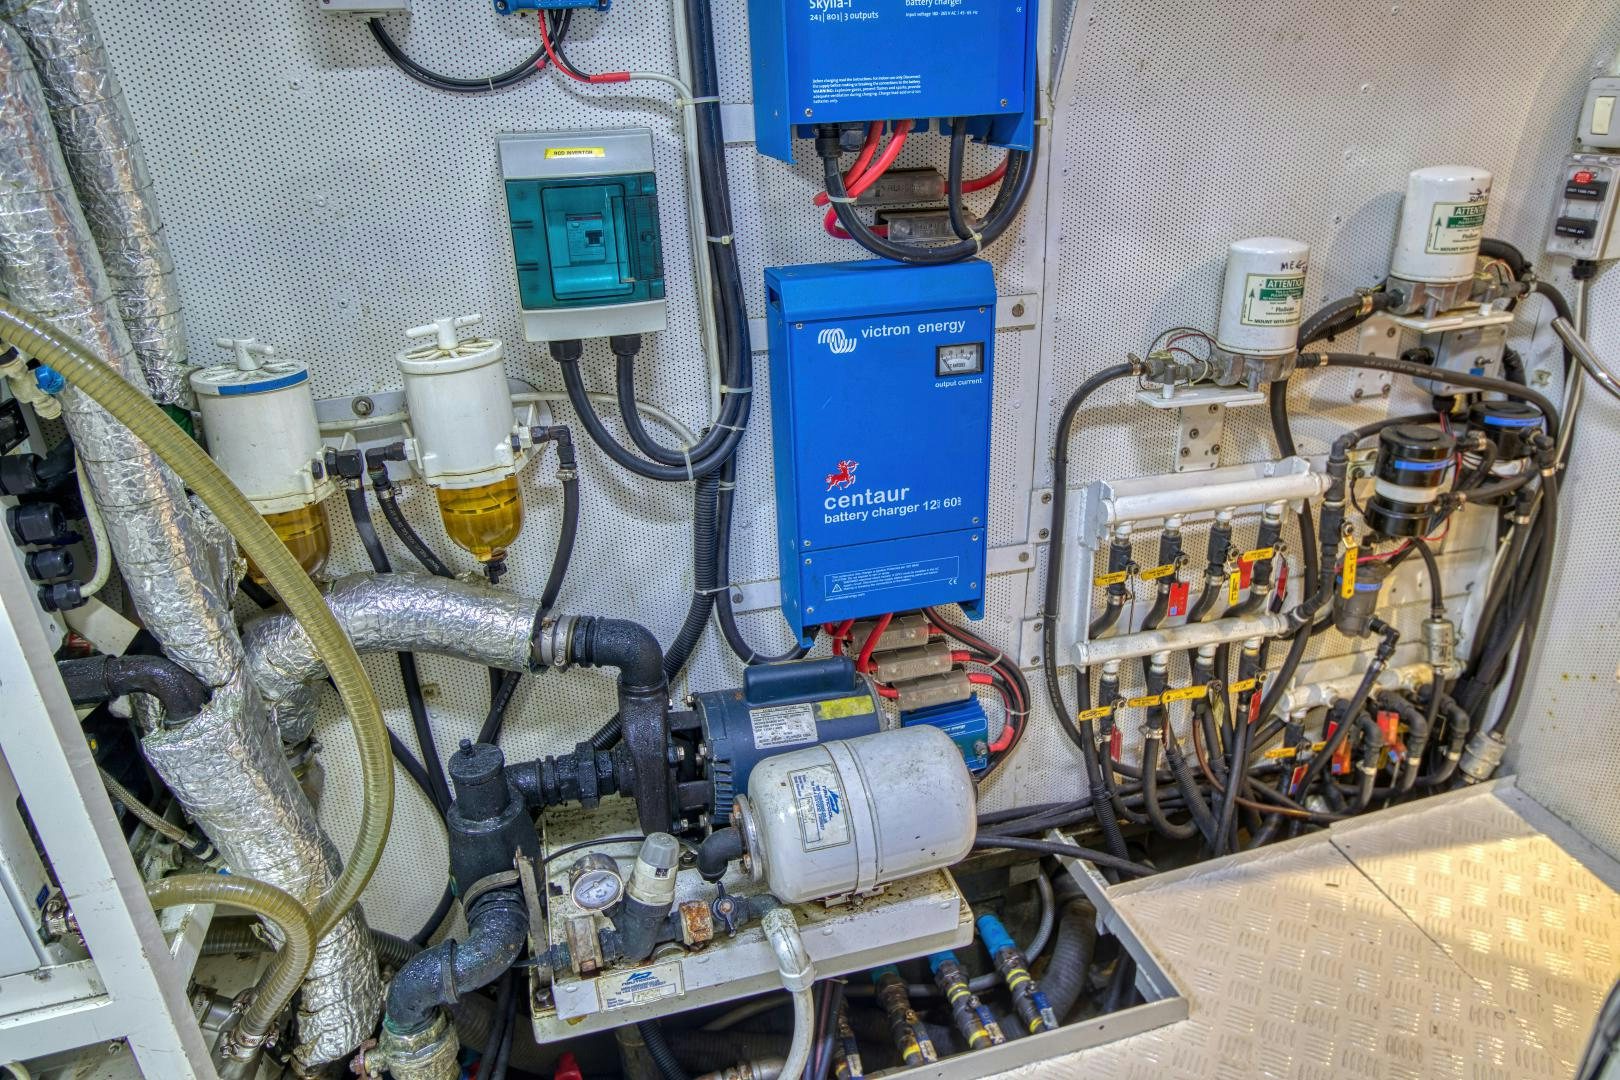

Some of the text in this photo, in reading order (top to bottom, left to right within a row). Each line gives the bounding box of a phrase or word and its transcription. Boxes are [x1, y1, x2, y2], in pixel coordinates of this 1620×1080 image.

[850, 12, 878, 20] outputs
[862, 321, 966, 338] victron energy
[935, 378, 983, 388] output current
[824, 488, 910, 510] centaur
[824, 510, 868, 524] battery
[872, 504, 920, 518] charger
